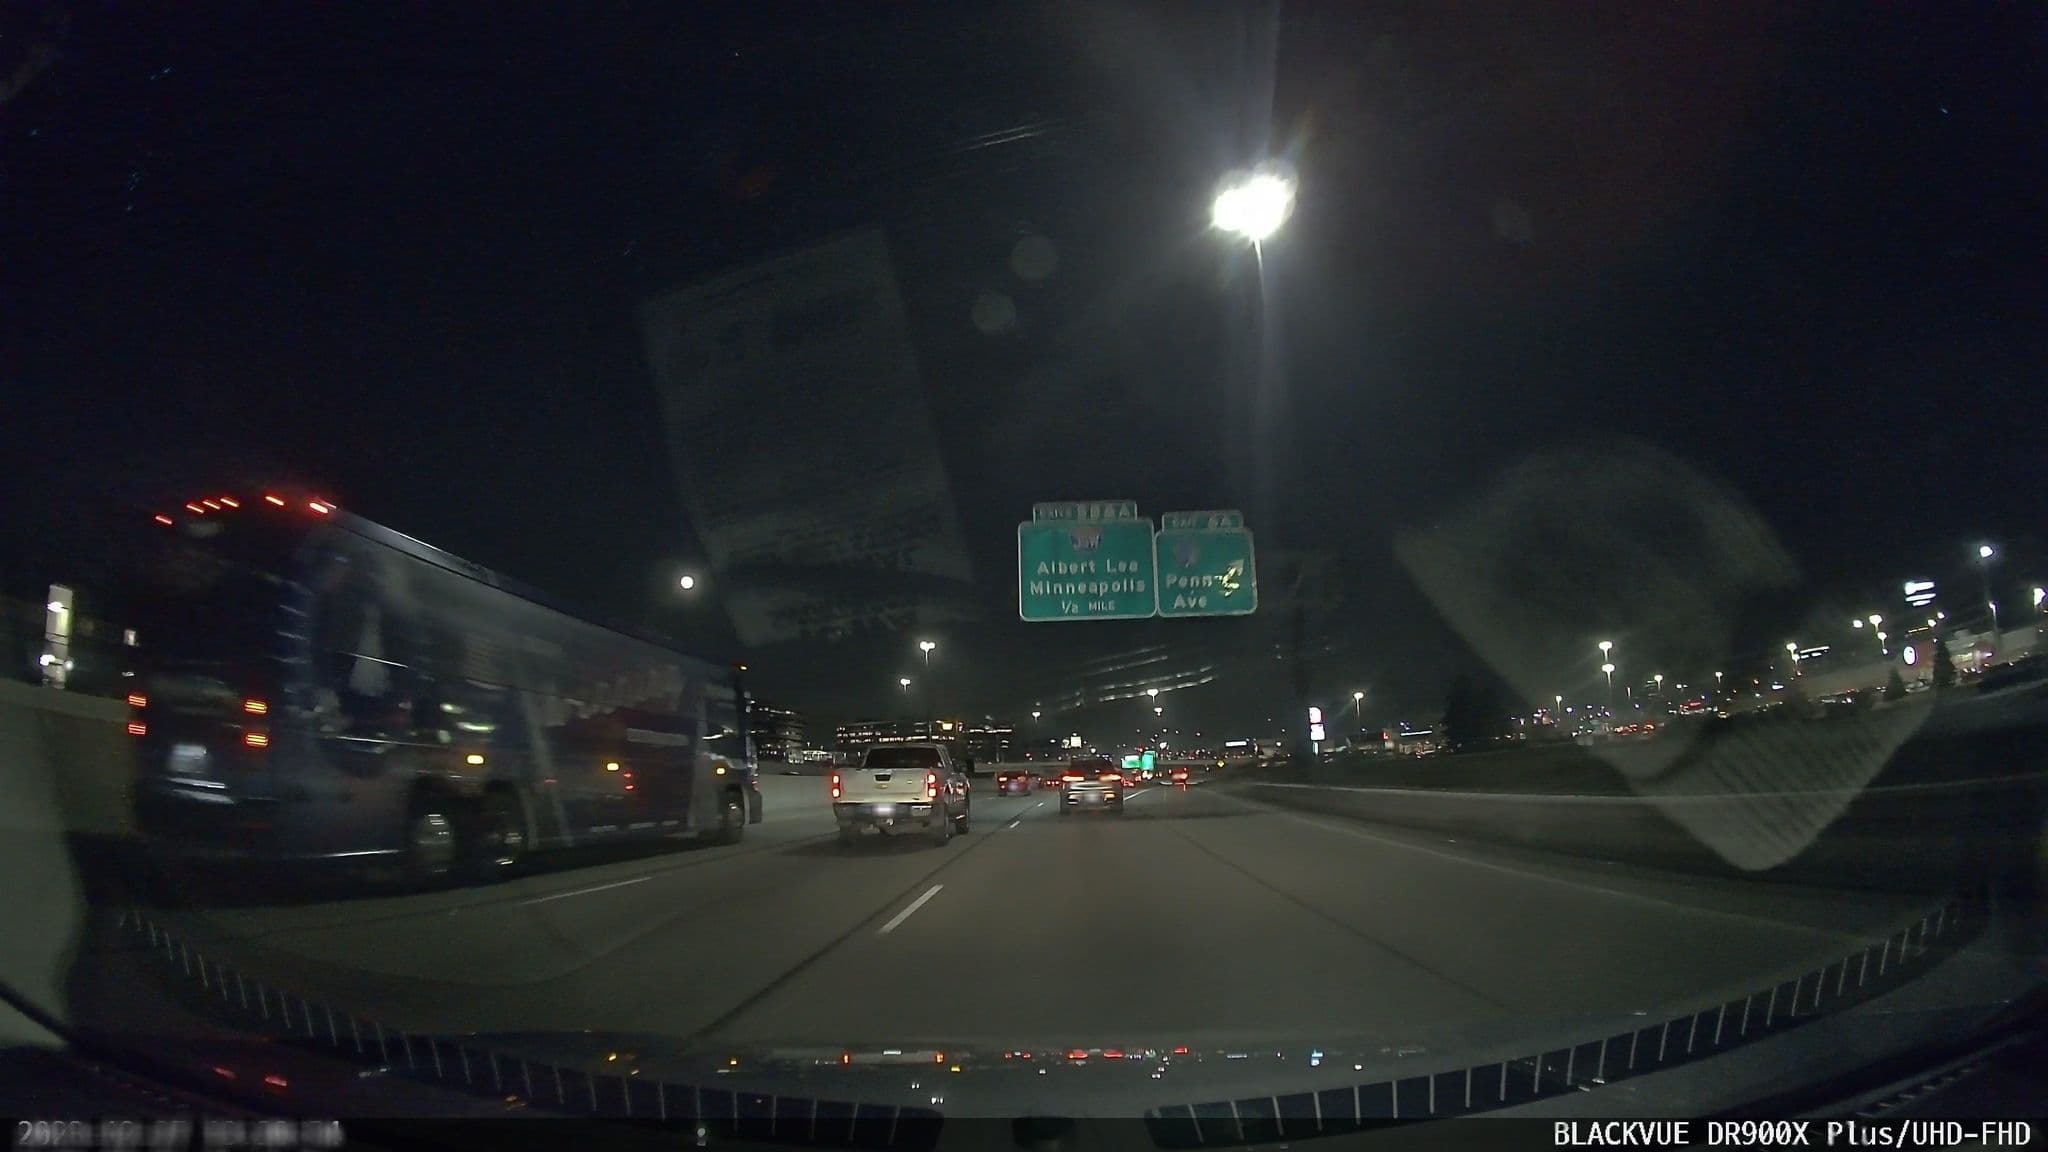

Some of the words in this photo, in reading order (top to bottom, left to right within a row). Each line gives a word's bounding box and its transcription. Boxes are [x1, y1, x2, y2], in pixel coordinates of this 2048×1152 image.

[1037, 559, 1096, 576] Albert
[1030, 577, 1146, 597] Minneapolis
[1165, 573, 1213, 590] Penn
[1088, 600, 1116, 612] MILE
[1173, 594, 1208, 609] Ave
